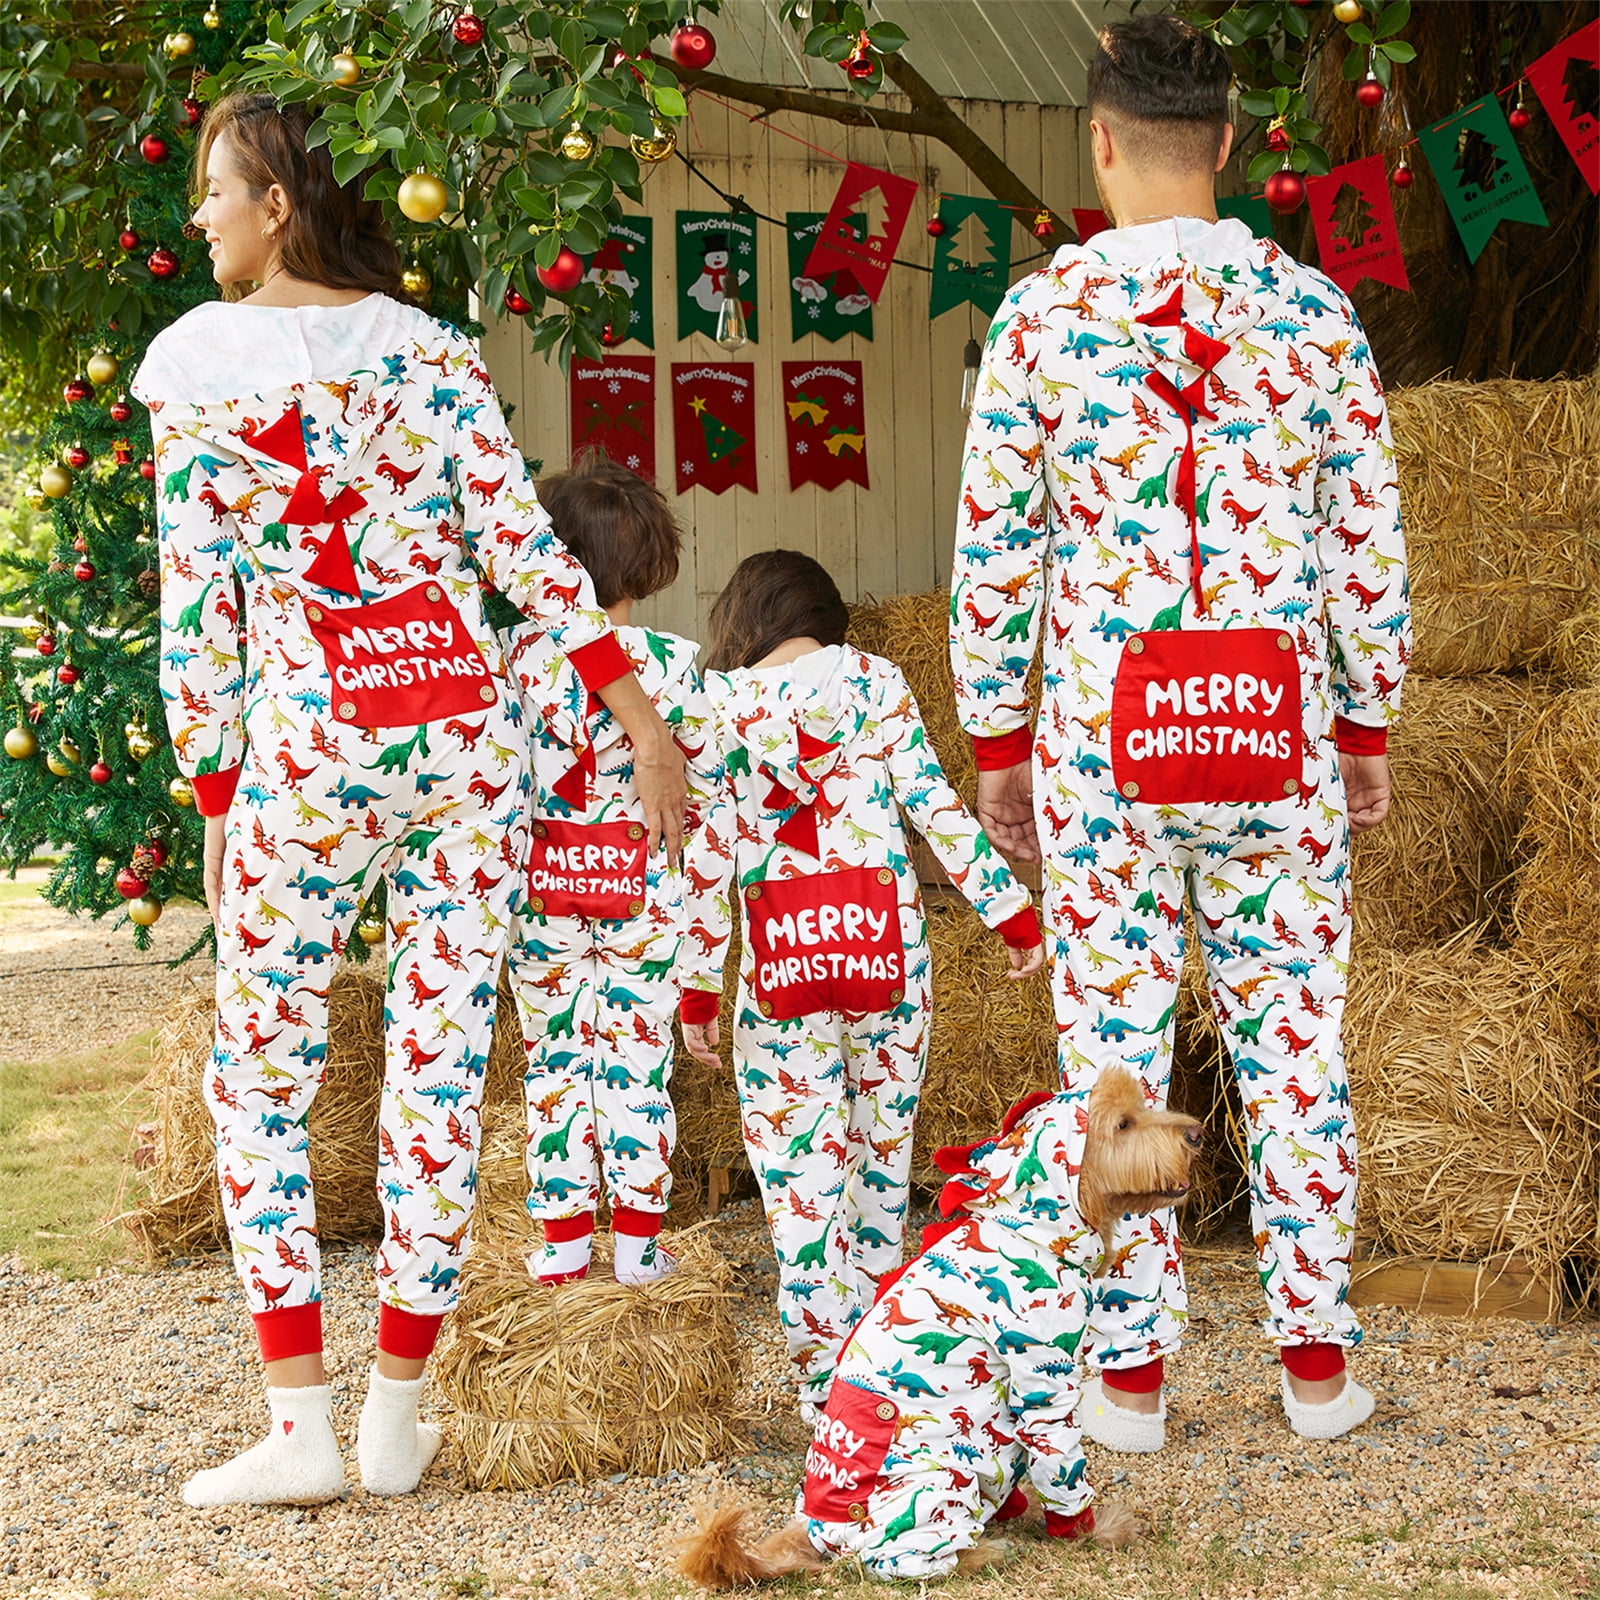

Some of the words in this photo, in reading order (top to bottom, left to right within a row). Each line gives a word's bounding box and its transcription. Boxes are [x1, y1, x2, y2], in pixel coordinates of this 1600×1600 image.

[338, 619, 454, 660] MERRY
[335, 652, 486, 691] CHRISTMAS
[1145, 673, 1284, 718] MERRY
[1126, 725, 1291, 761] CHRISTMAS
[545, 844, 638, 872] MERRY
[531, 869, 643, 896] CHRISTMAS
[765, 902, 888, 952] MERRY
[760, 952, 900, 992] CHRISTMAS
